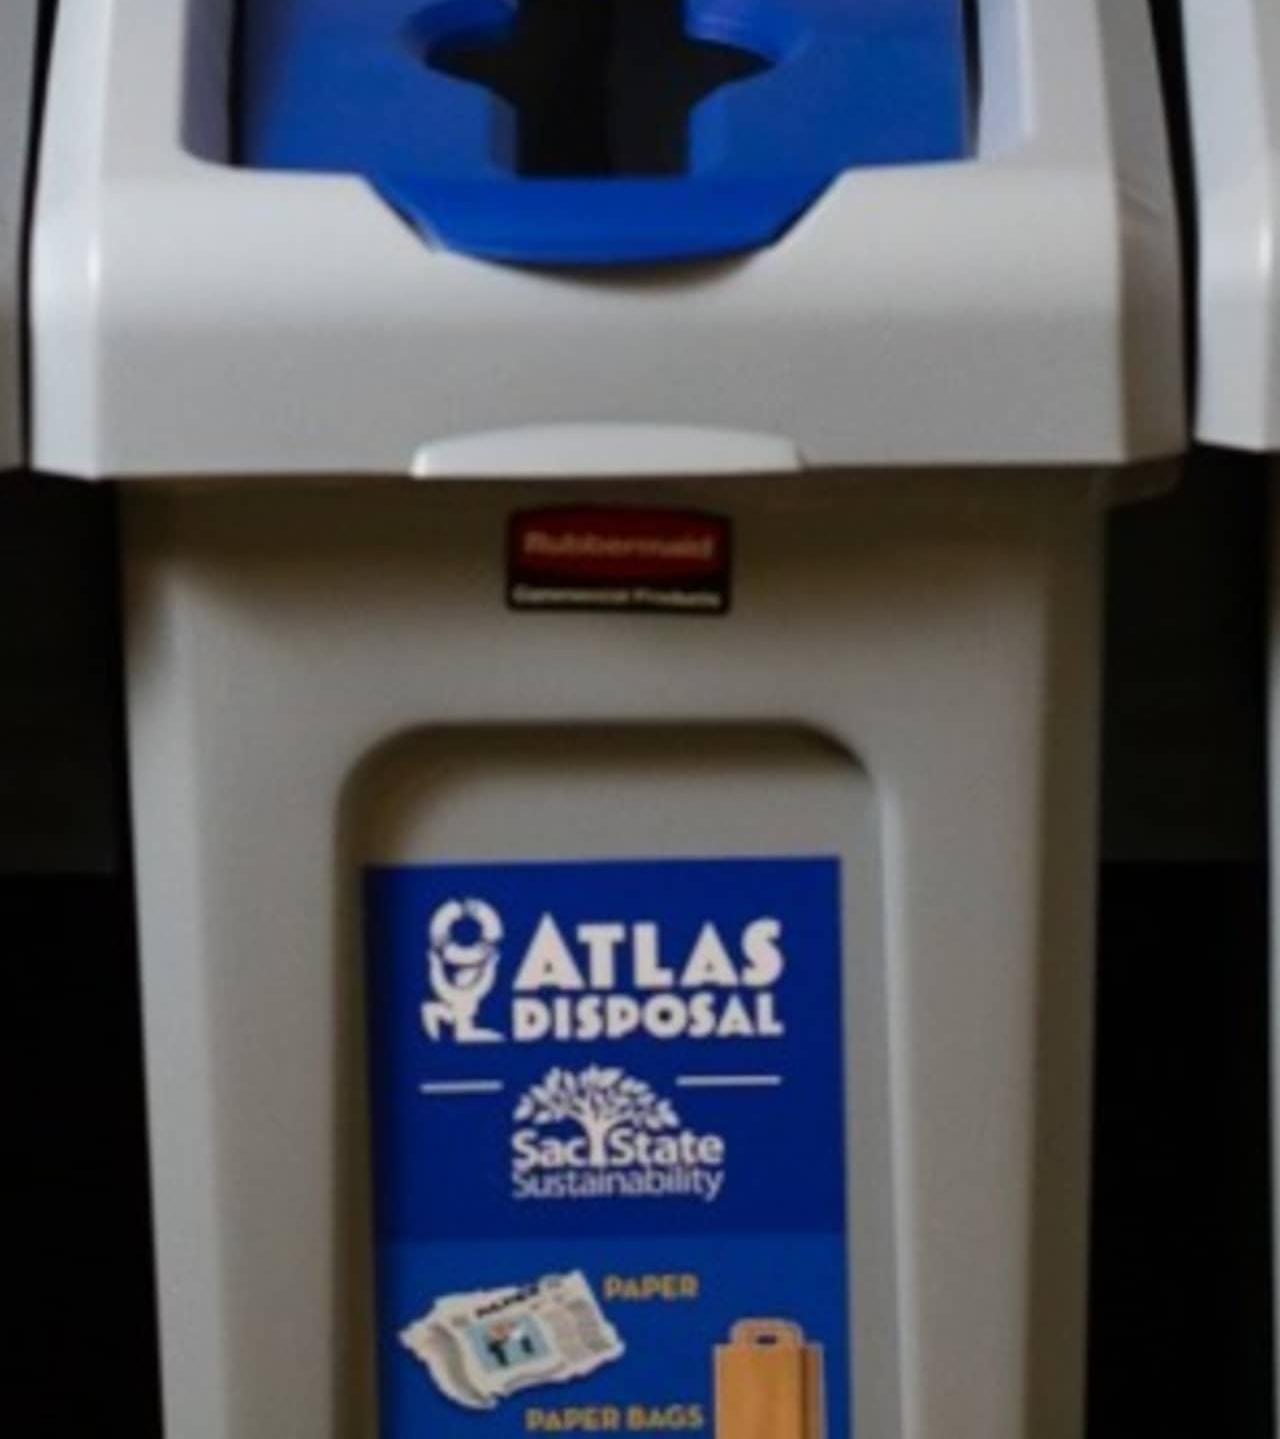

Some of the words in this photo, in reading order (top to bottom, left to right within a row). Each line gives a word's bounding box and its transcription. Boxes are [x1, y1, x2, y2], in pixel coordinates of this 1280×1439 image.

[513, 912, 785, 990] ATLAS
[512, 994, 784, 1042] DISPOSAL
[511, 1128, 584, 1168] Sac
[609, 1127, 725, 1166] State
[512, 1166, 725, 1202] Sustainability
[604, 1274, 699, 1300] PAPER
[526, 1406, 619, 1432] PAPER
[626, 1405, 703, 1429] BAGS
